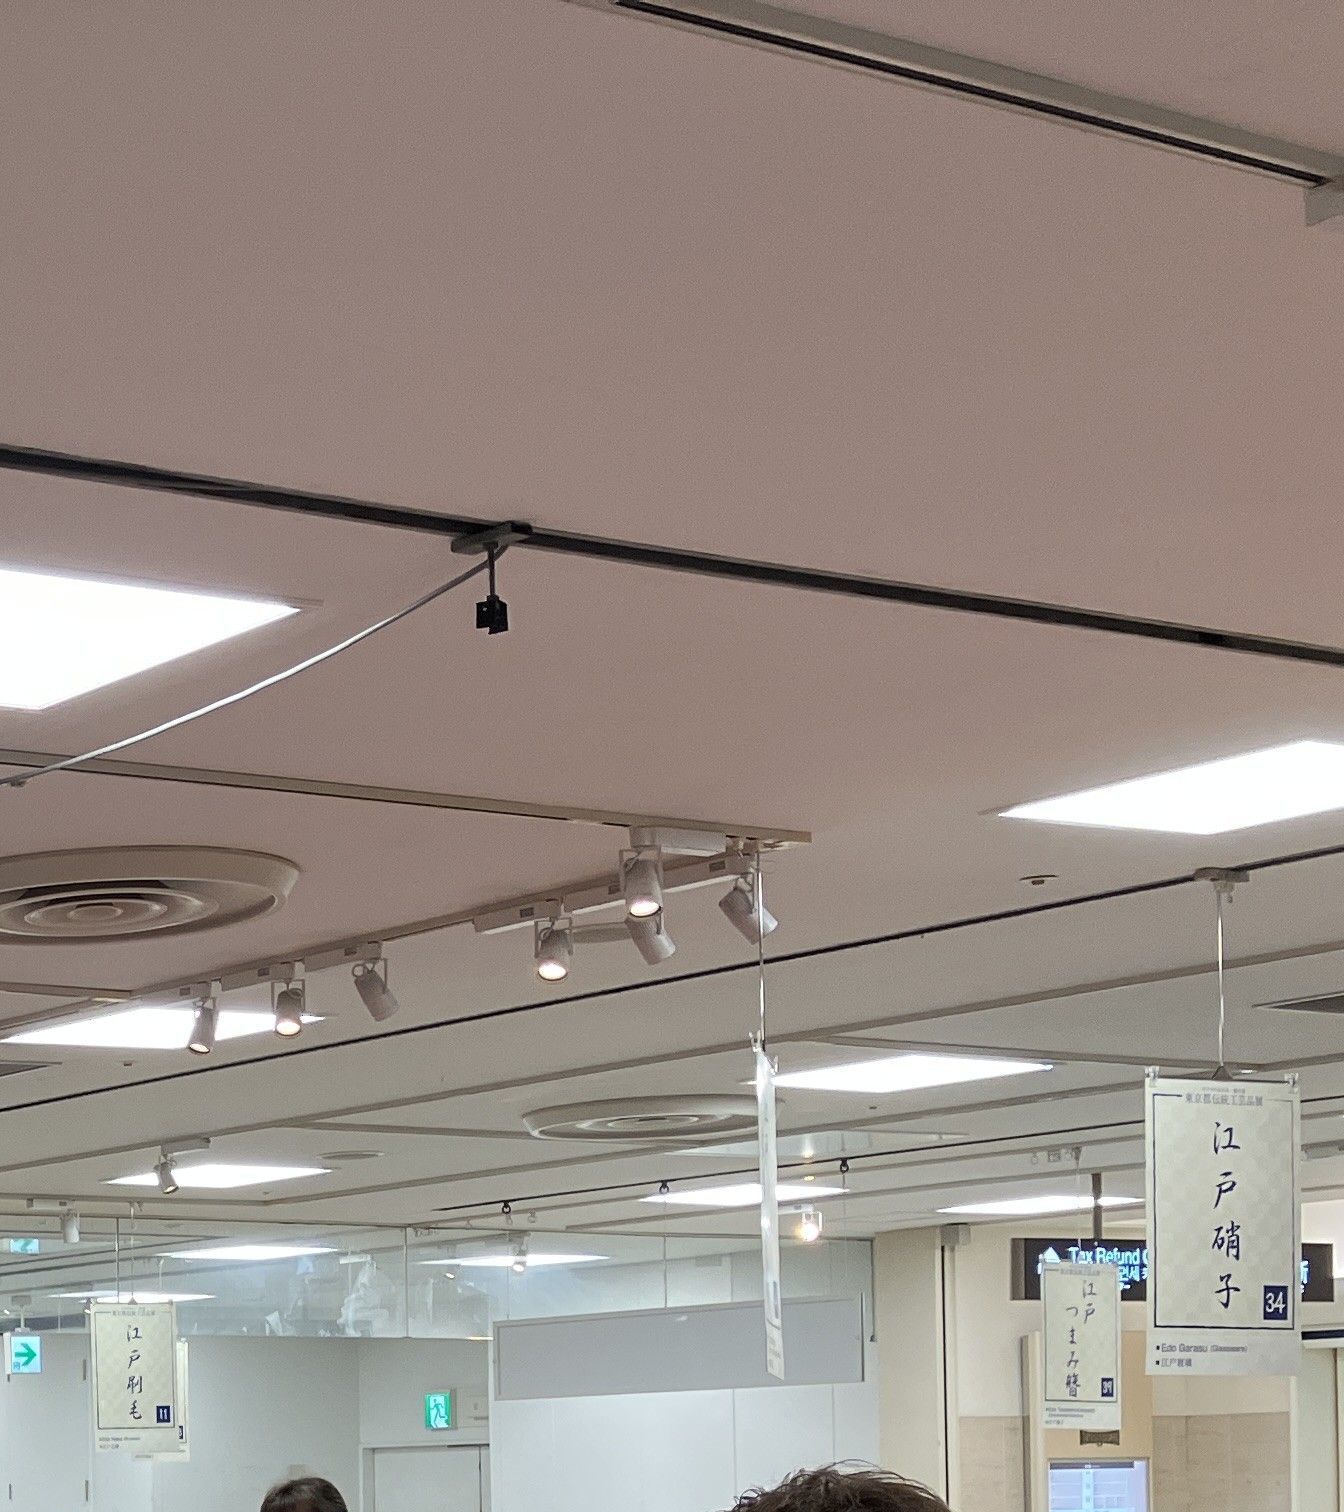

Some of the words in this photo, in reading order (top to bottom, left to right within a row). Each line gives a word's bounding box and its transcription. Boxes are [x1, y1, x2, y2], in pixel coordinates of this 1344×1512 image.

[1212, 1122, 1241, 1310] 江戸硝子
[1096, 1247, 1140, 1264] Refund
[1083, 1280, 1097, 1324] 江戸
[1265, 1292, 1285, 1315] 34
[126, 1325, 143, 1420] 江戸刷毛
